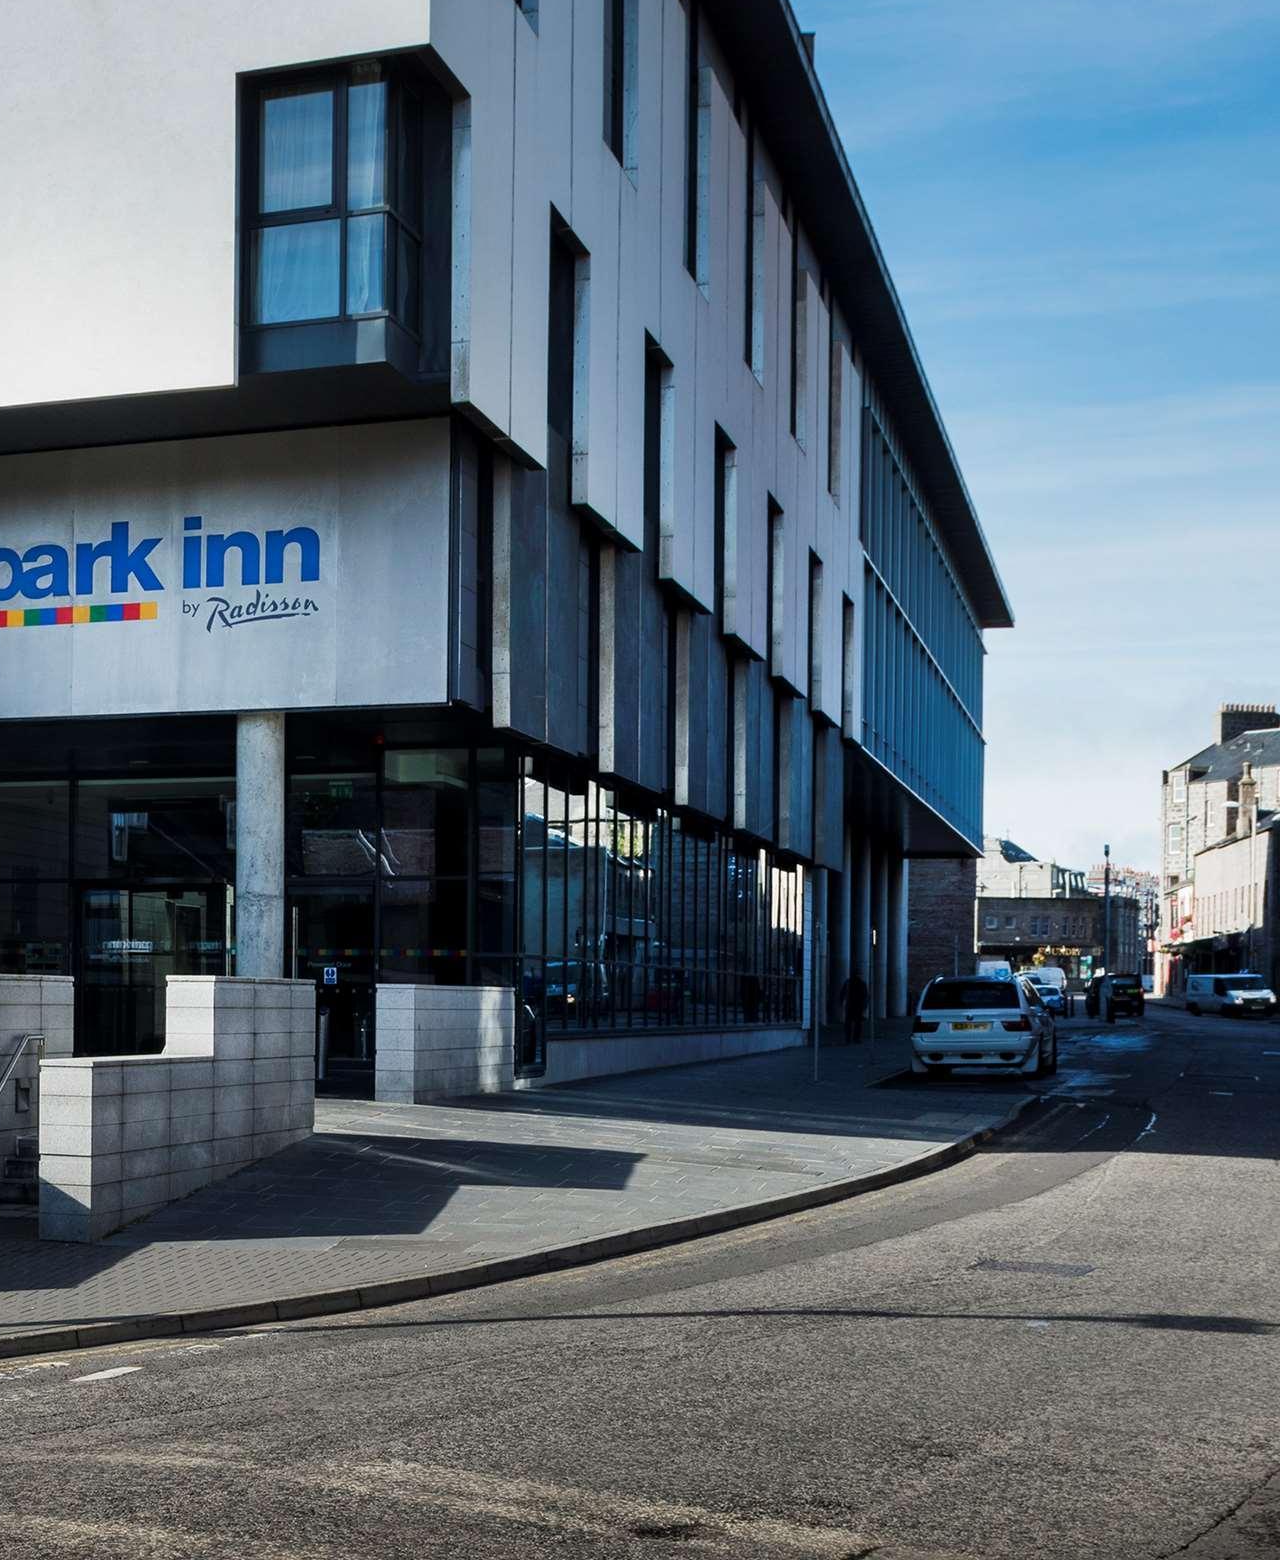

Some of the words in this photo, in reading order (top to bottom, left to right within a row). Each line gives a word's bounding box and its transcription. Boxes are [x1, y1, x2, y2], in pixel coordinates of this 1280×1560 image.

[183, 516, 320, 589] inn
[182, 600, 200, 617] by
[206, 590, 319, 633] Radisson
